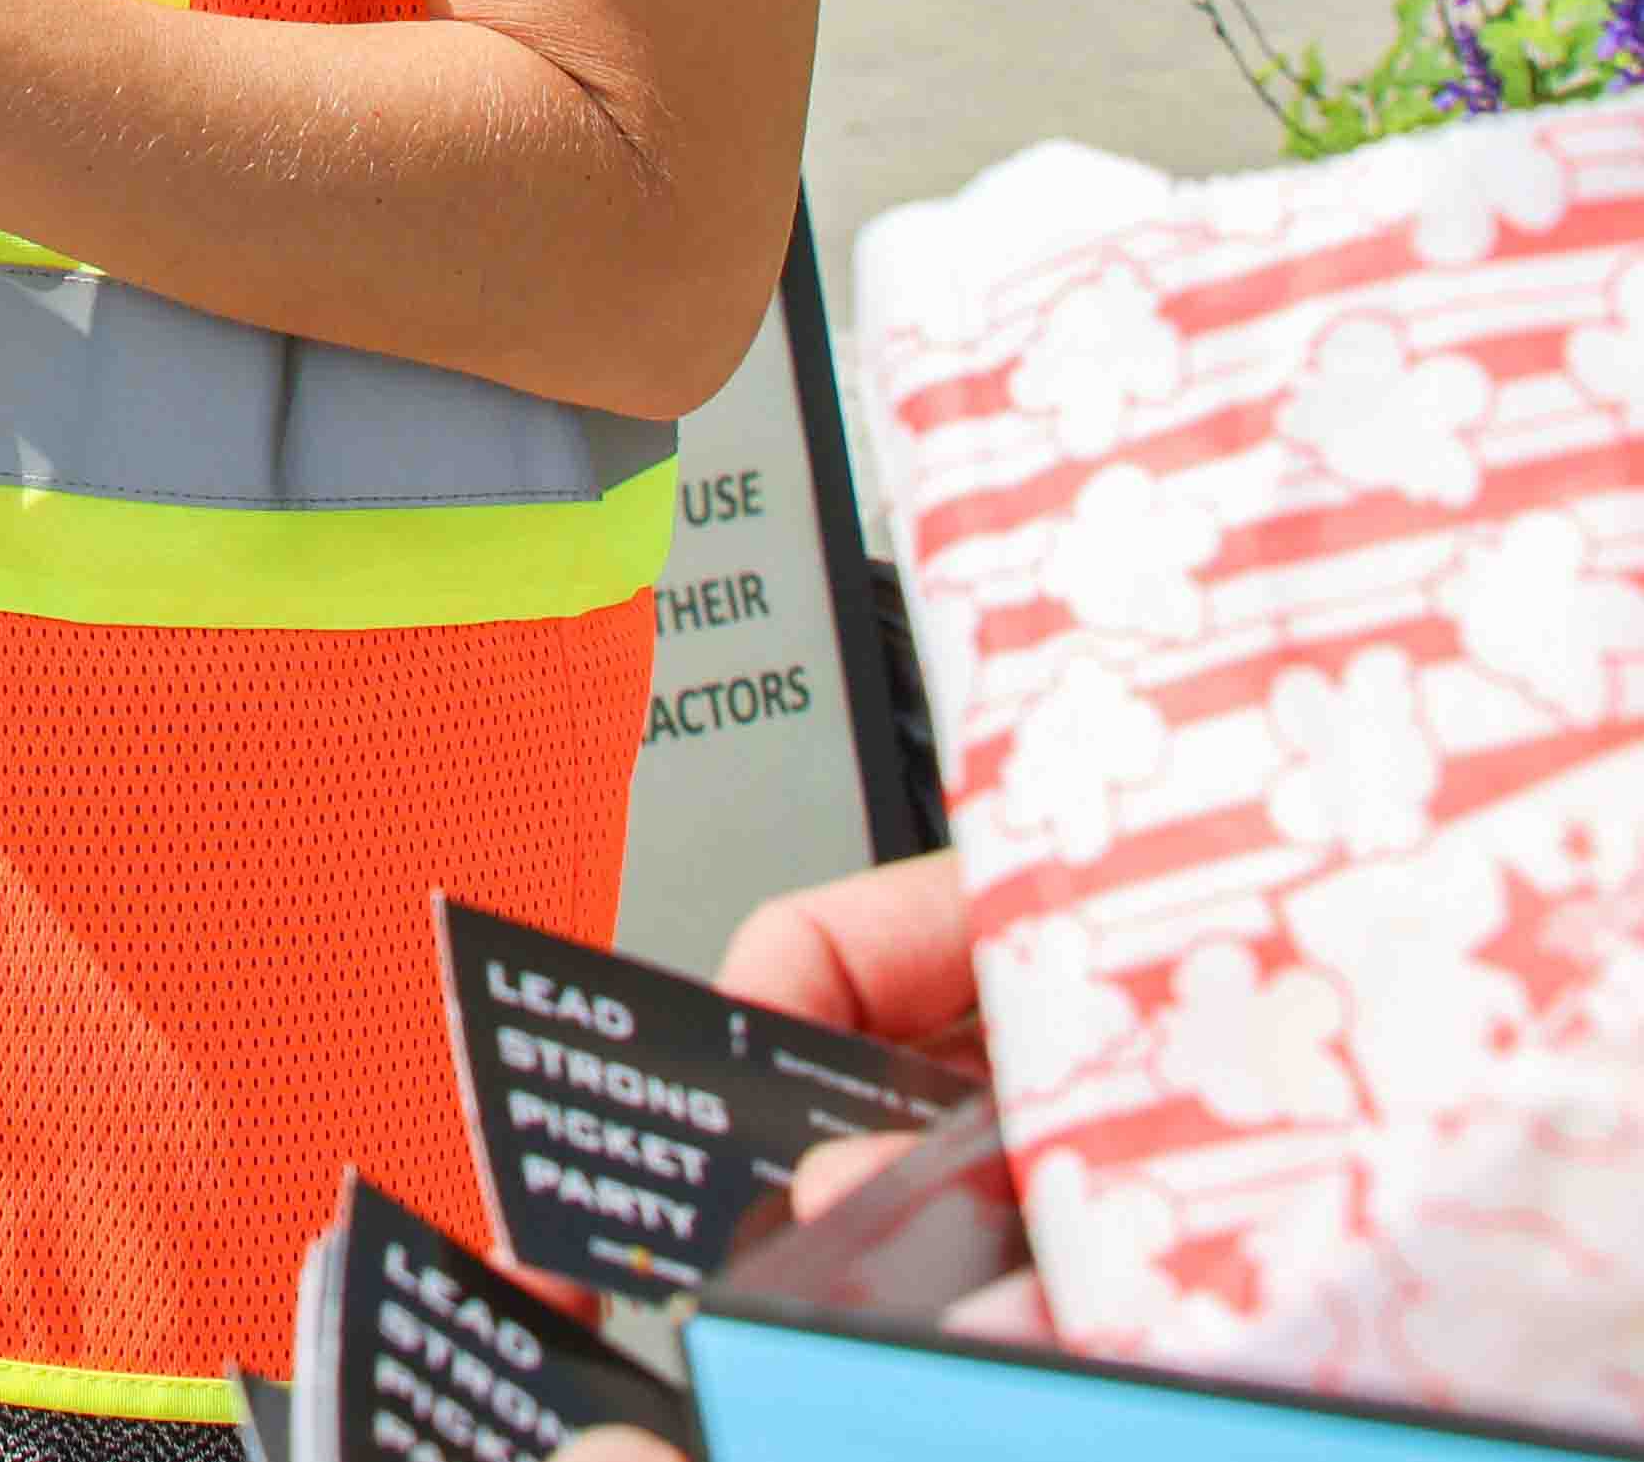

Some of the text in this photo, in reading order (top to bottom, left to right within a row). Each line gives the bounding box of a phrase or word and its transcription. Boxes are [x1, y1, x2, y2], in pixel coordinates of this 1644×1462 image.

[682, 470, 764, 527] USE
[654, 570, 770, 637] THEIR
[642, 665, 810, 747] ACTORS
[485, 959, 635, 1041] LEAD
[495, 1026, 731, 1134] STRONG
[507, 1088, 708, 1184] PICKET
[520, 1152, 700, 1240] PARTY
[384, 1240, 544, 1372] LEAD
